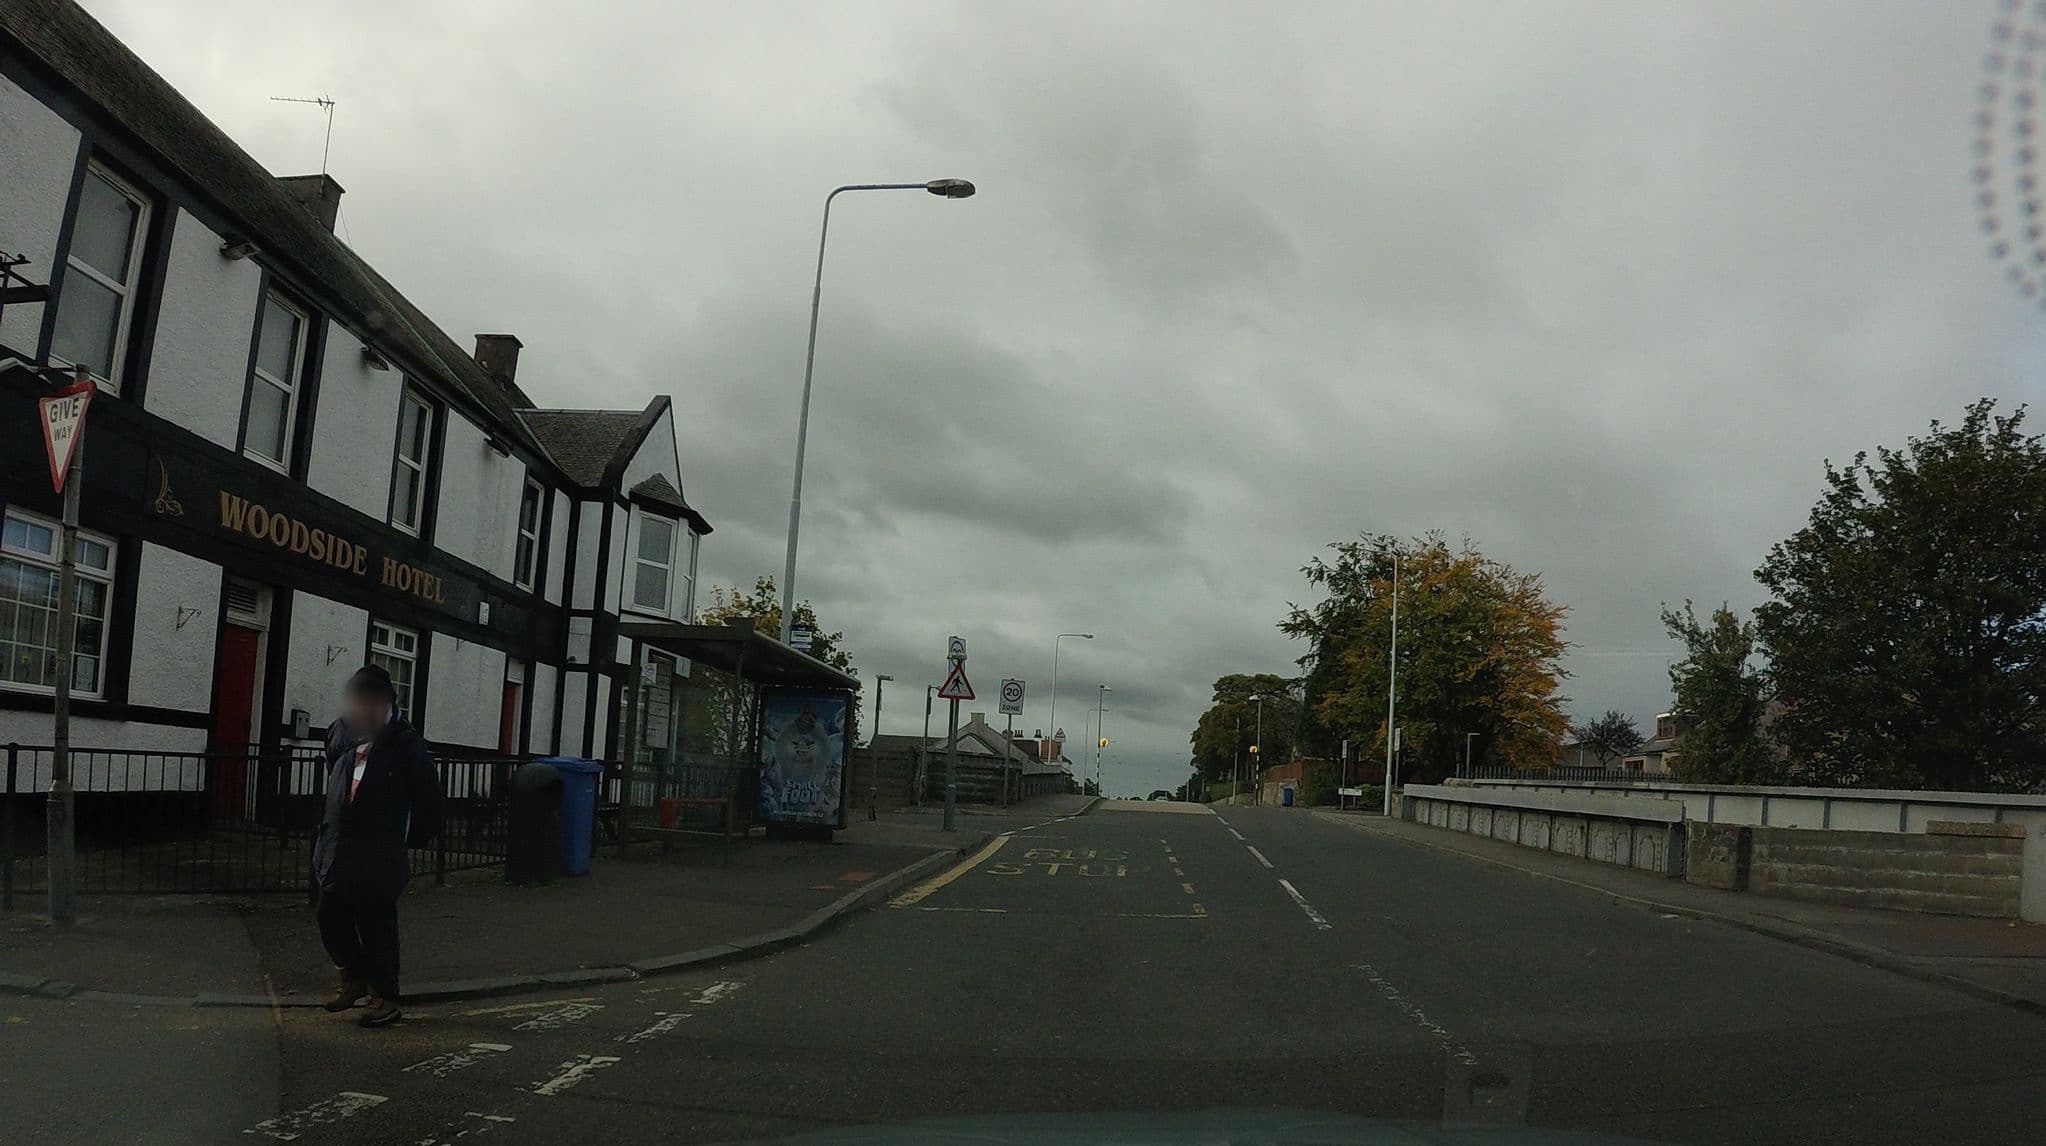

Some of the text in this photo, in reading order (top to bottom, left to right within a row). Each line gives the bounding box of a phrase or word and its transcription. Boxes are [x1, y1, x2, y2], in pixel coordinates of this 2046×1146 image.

[49, 397, 80, 423] GIVE
[54, 425, 73, 441] WAY
[219, 490, 445, 604] WOODSIDE HOTEL
[1006, 687, 1020, 697] 20
[1002, 703, 1020, 712] ZONE
